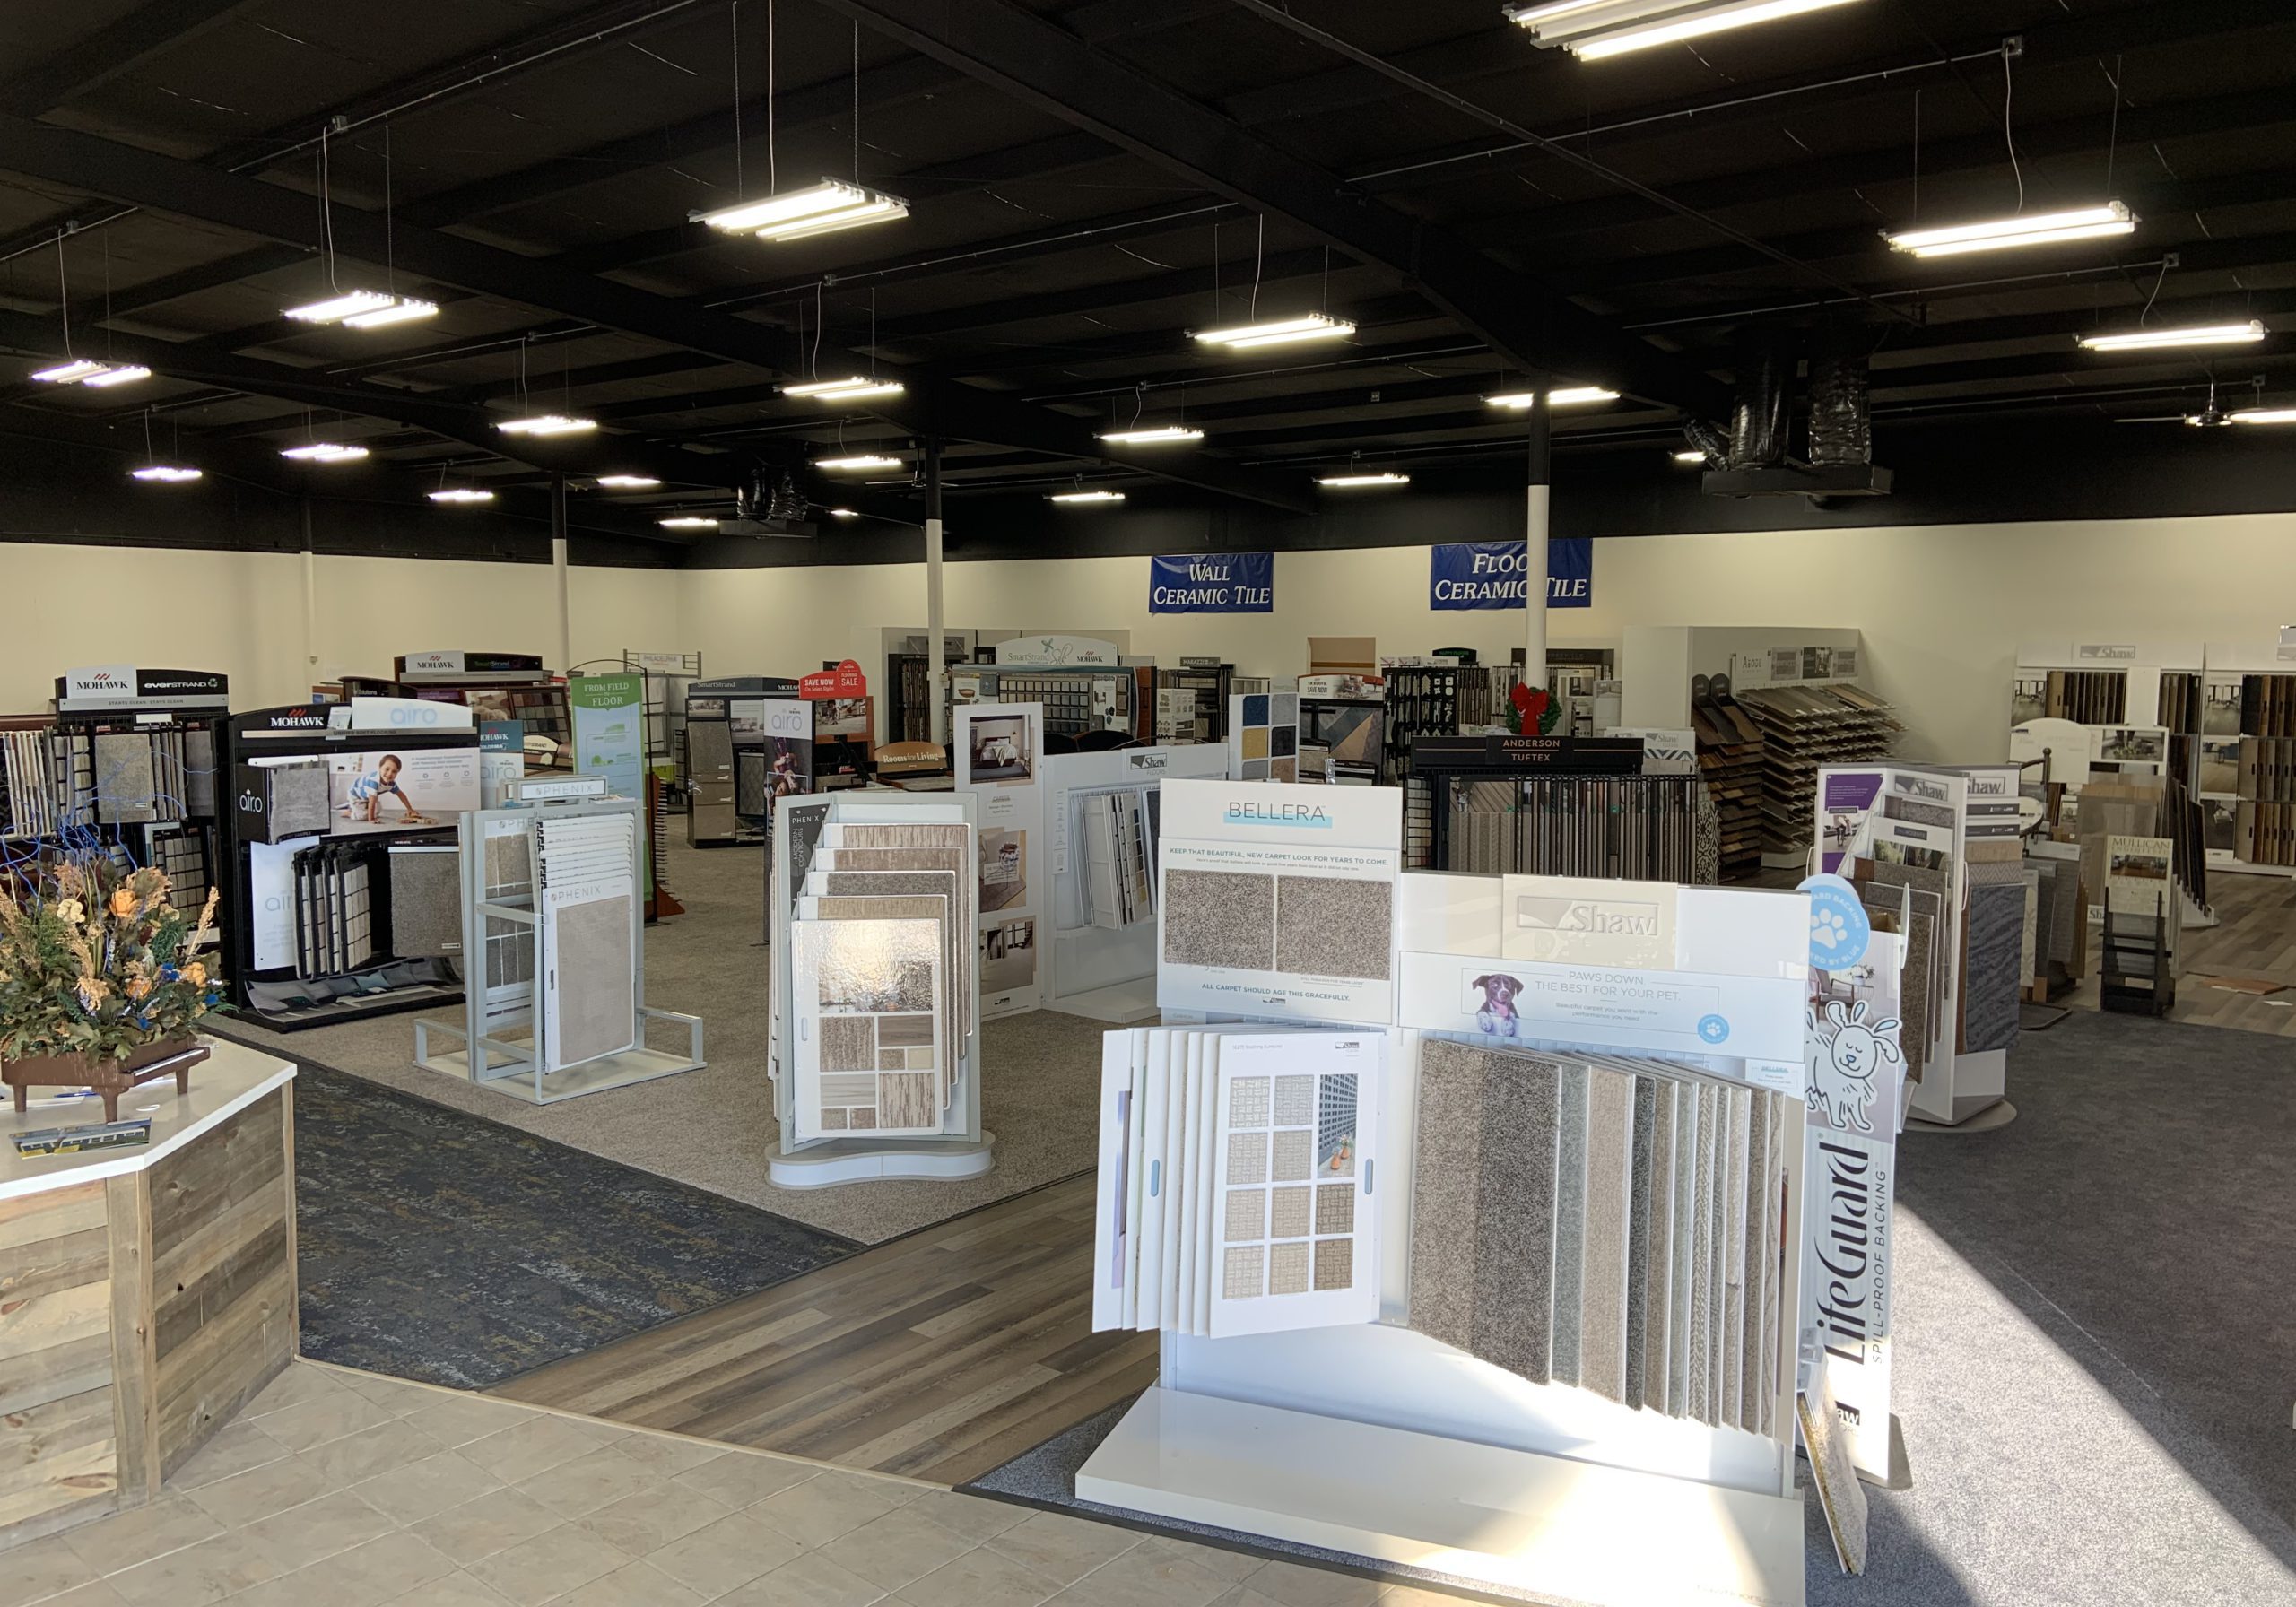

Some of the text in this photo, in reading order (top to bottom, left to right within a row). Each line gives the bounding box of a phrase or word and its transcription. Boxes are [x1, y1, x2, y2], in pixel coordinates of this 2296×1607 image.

[1472, 552, 1527, 574] FLOO
[1189, 563, 1231, 582] WALL
[1153, 586, 1271, 604] CERAMIC TILE
[416, 661, 454, 669] MOHAWK
[76, 680, 128, 690] MOHAWK
[584, 682, 630, 692] FROM FIELD
[697, 681, 735, 689] SmartStrand
[804, 678, 834, 686] SAVE NOW
[841, 677, 859, 686] SALE
[592, 696, 624, 707] FLOOR
[271, 717, 324, 727] MOHAWK
[389, 706, 439, 726] airo
[770, 714, 803, 732] airo
[1502, 739, 1561, 747] ANDERSON
[883, 754, 908, 763] Rooms
[916, 751, 939, 761] Living
[1144, 756, 1166, 769] Shaw
[1511, 753, 1551, 761] TUFTEX
[544, 785, 594, 795] PHENIX
[1915, 779, 1945, 800] Shaw
[239, 790, 263, 813] airo
[1229, 801, 1326, 822] BELLERA
[792, 814, 820, 824] PHENIX
[2112, 837, 2170, 849] MULLICAN
[1206, 849, 1245, 858] BEAUTIFUL,
[558, 884, 601, 901] PHENIX
[265, 889, 294, 912] air
[1570, 904, 1656, 937] Shaw
[1569, 970, 1602, 983] PAWS
[1215, 984, 1241, 992] CARPET
[1243, 986, 1271, 995] SHOULD
[1288, 989, 1303, 997] THIS
[1535, 980, 1558, 992] THE
[1561, 983, 1590, 994] BEST
[1593, 986, 1618, 996] FOR
[1621, 987, 1654, 999] YOUR
[1555, 1002, 1582, 1010] Beautiful
[1583, 1004, 1604, 1012] carpet
[1571, 1011, 1610, 1020] performance
[1611, 1013, 1623, 1021] you
[1872, 1170, 1886, 1364] SPILL-PROOF BACKING
